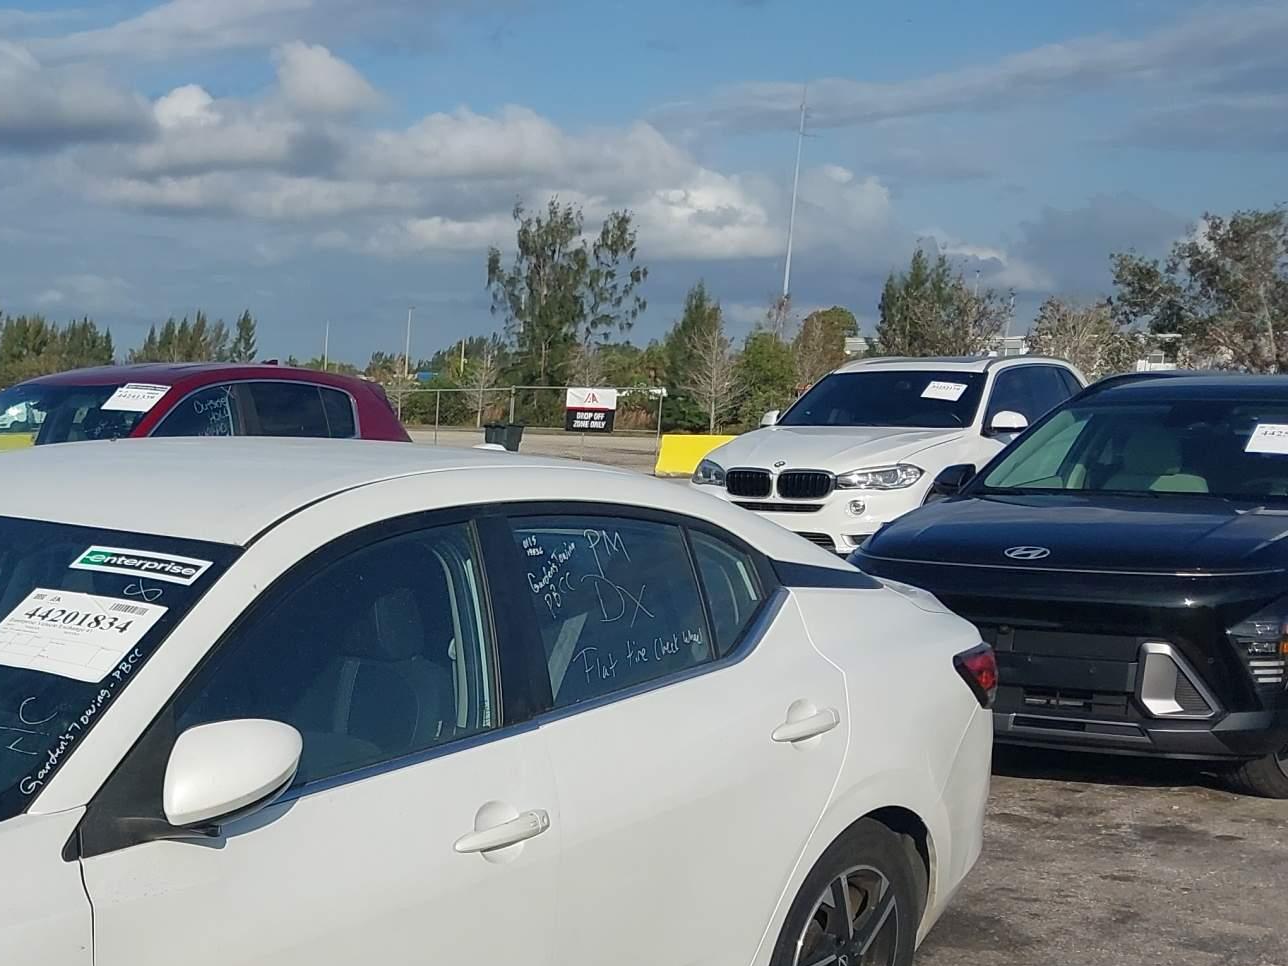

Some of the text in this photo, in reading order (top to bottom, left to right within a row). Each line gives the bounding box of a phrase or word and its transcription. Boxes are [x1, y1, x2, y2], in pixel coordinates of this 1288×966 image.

[572, 420, 607, 429] ZONE ONLY
[576, 412, 605, 421] DROP OFF
[85, 552, 196, 576] enterprise
[24, 606, 134, 633] 44201834
[112, 648, 144, 682] PBCC
[573, 647, 618, 684] Flat
